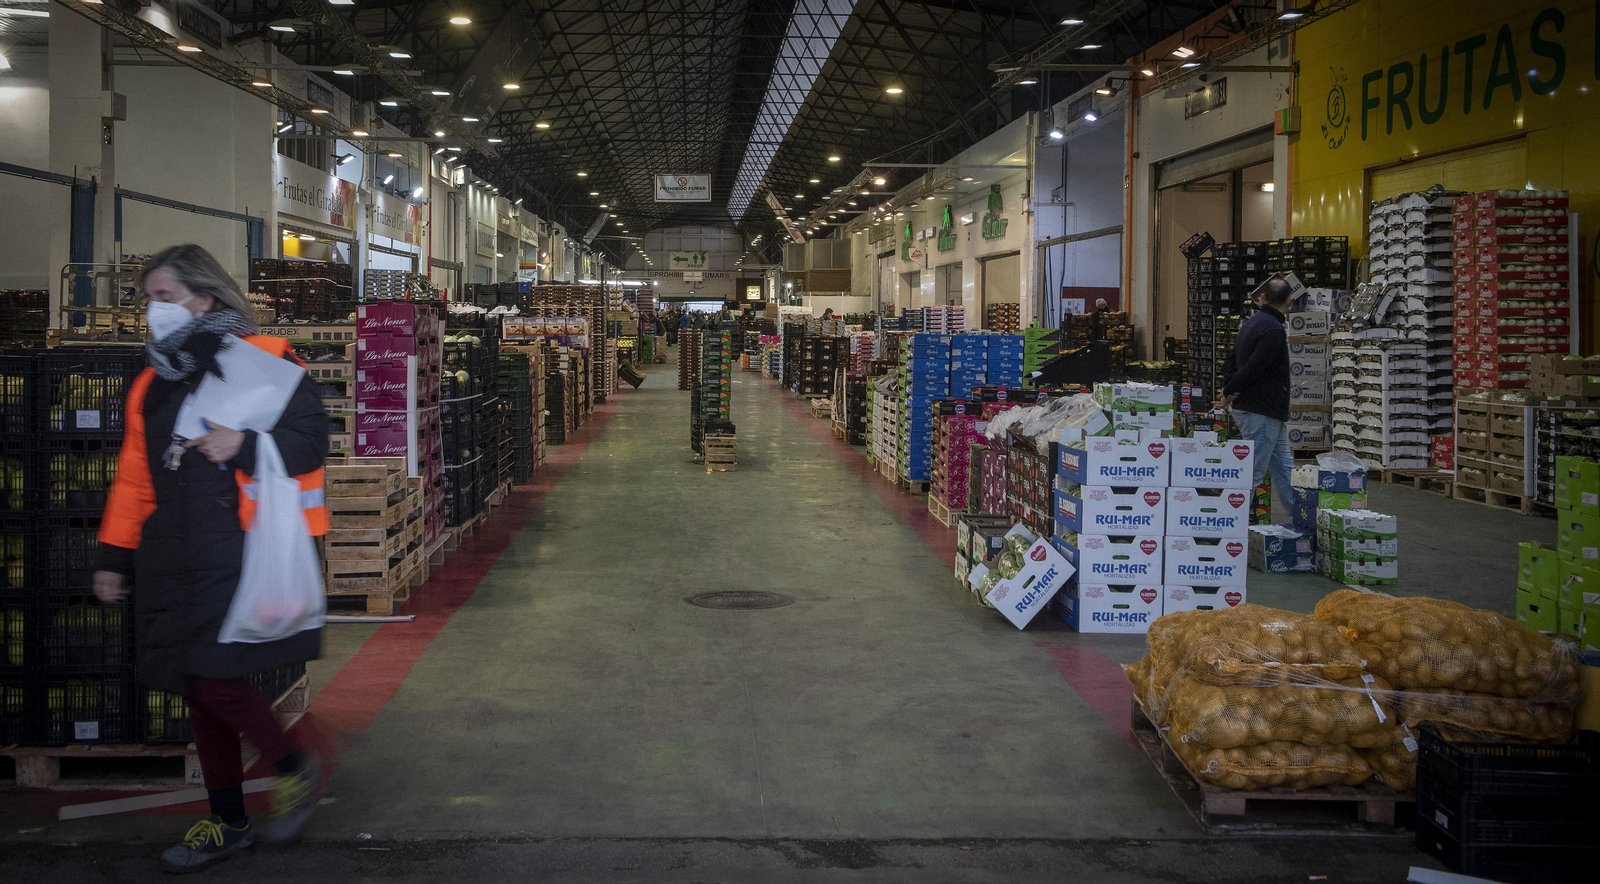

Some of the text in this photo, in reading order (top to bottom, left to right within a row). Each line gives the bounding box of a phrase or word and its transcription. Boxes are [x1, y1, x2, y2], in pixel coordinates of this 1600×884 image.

[1361, 7, 1566, 141] FRUTAS
[283, 177, 307, 204] Frutas
[309, 186, 315, 206] el
[362, 317, 408, 328] La Nena
[362, 349, 408, 360] La Nena
[362, 381, 407, 392] La Nena
[362, 413, 406, 424] La Nena
[362, 444, 408, 455] La Nena
[1031, 583, 1054, 607] HORTALIZAS
